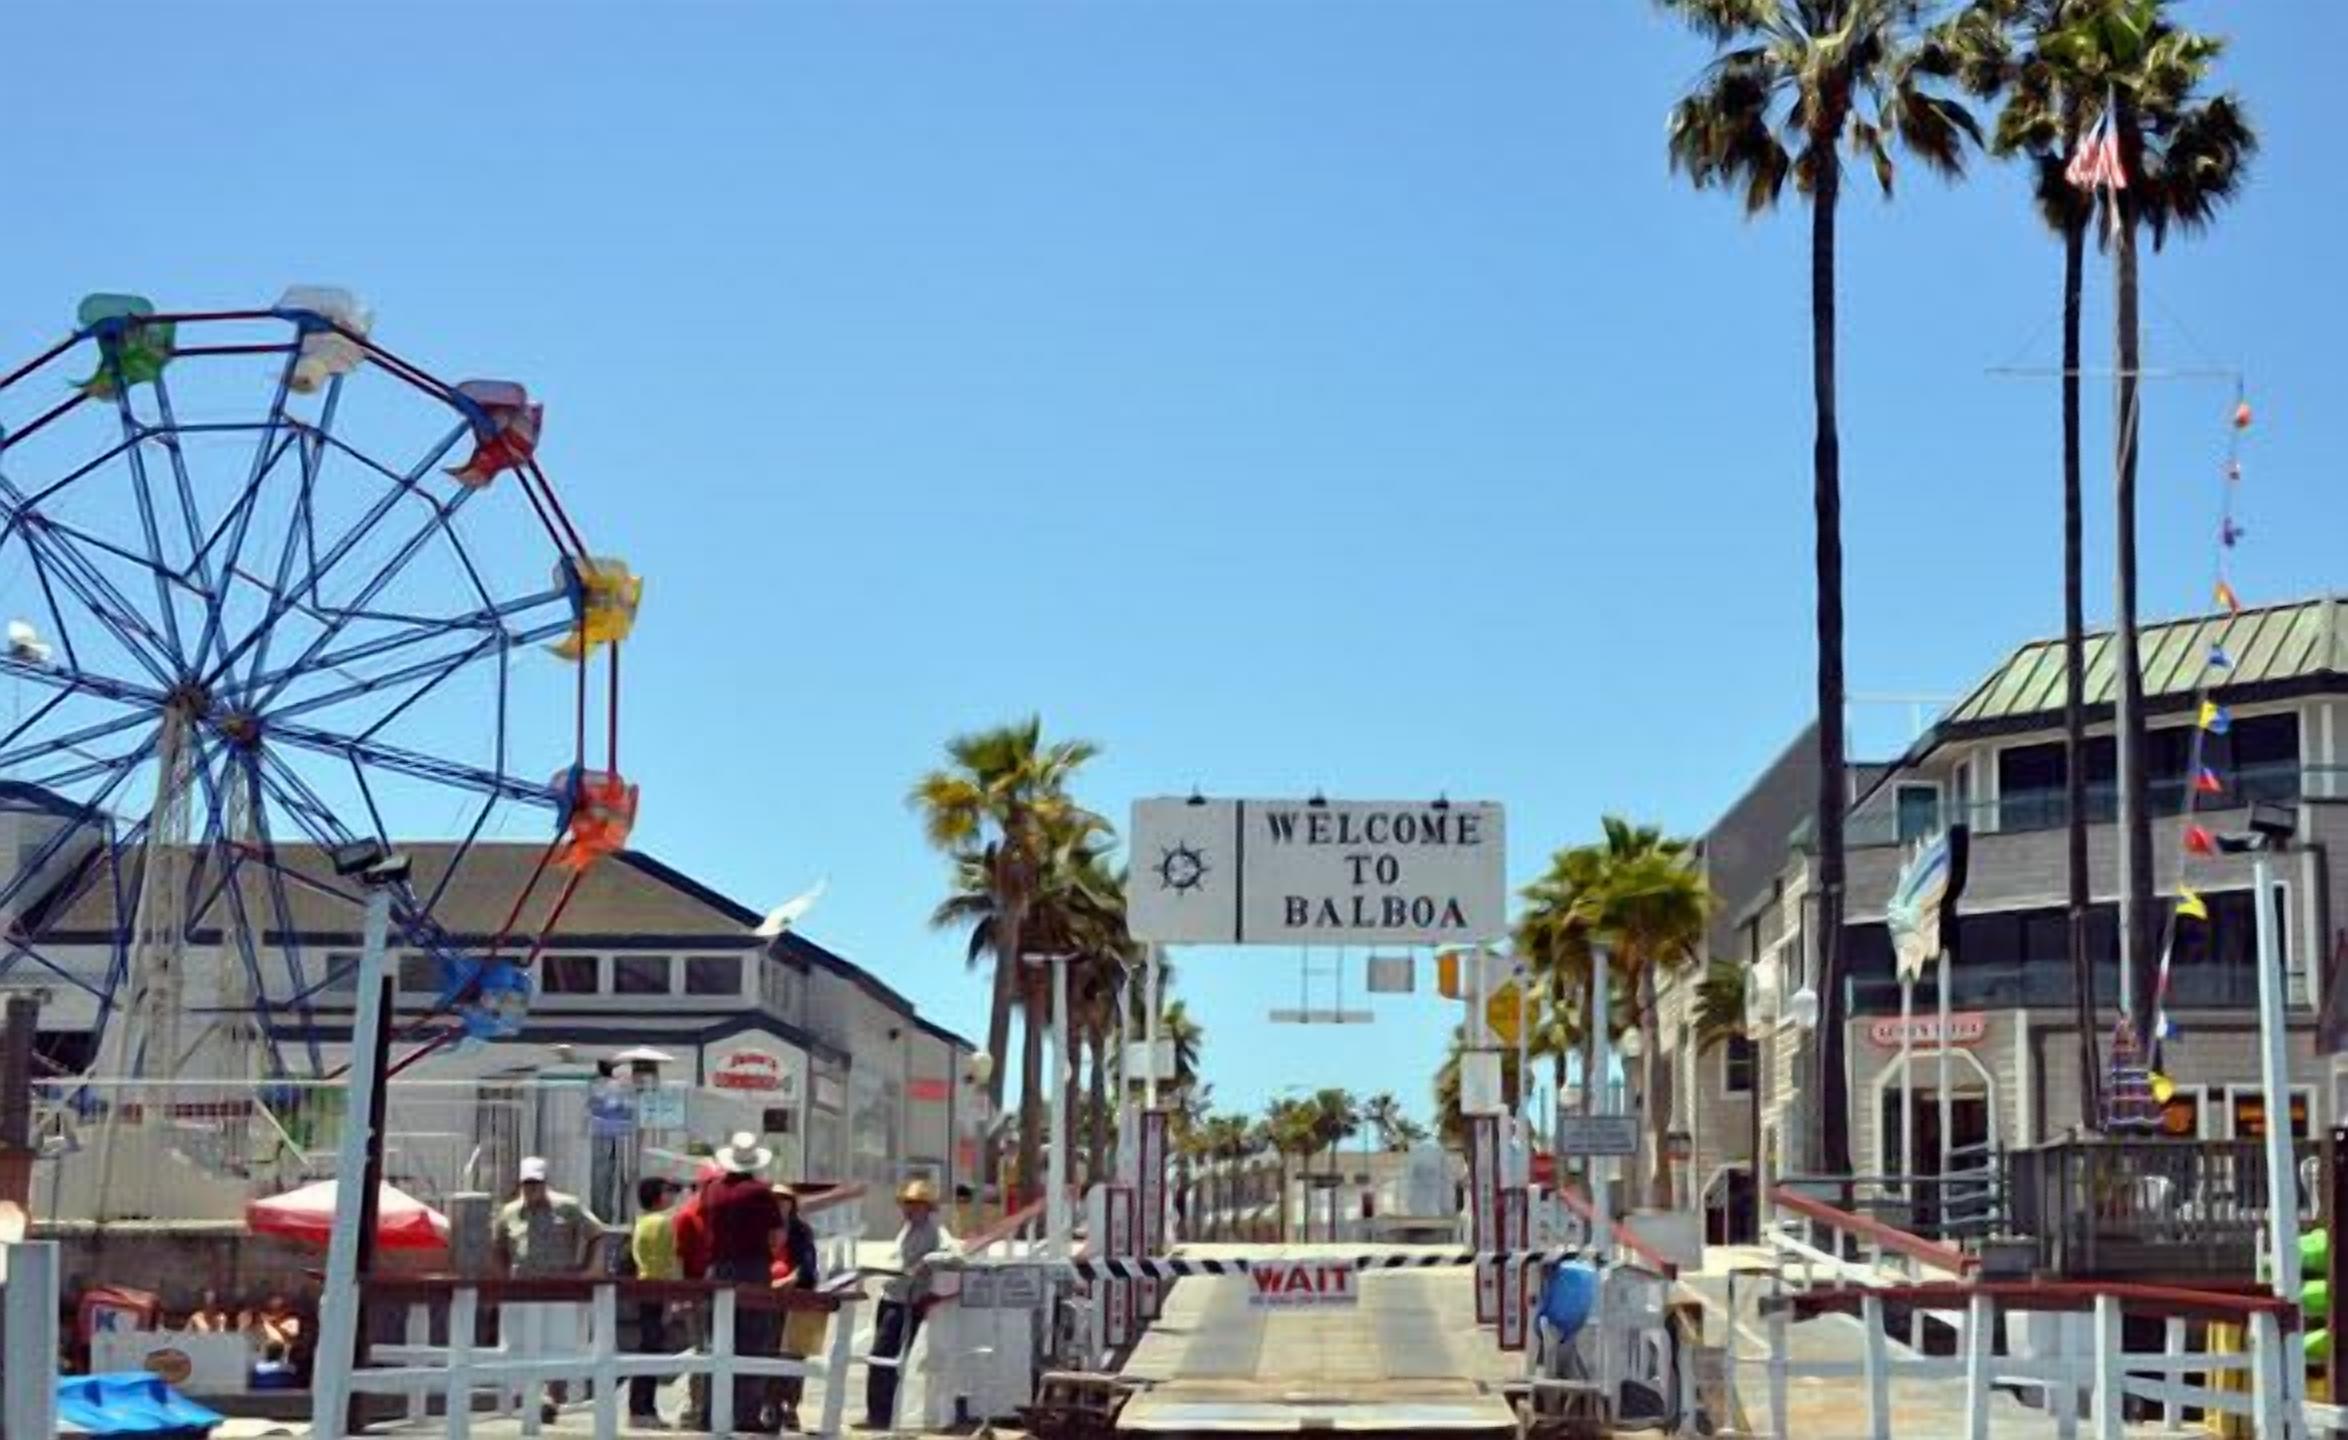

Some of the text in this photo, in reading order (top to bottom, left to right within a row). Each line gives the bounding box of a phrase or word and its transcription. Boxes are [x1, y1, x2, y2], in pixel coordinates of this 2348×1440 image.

[1266, 811, 1482, 845] WELCOME
[1345, 854, 1400, 885] TO
[1284, 896, 1467, 928] BALBOA
[1251, 1265, 1352, 1292] WAIT
